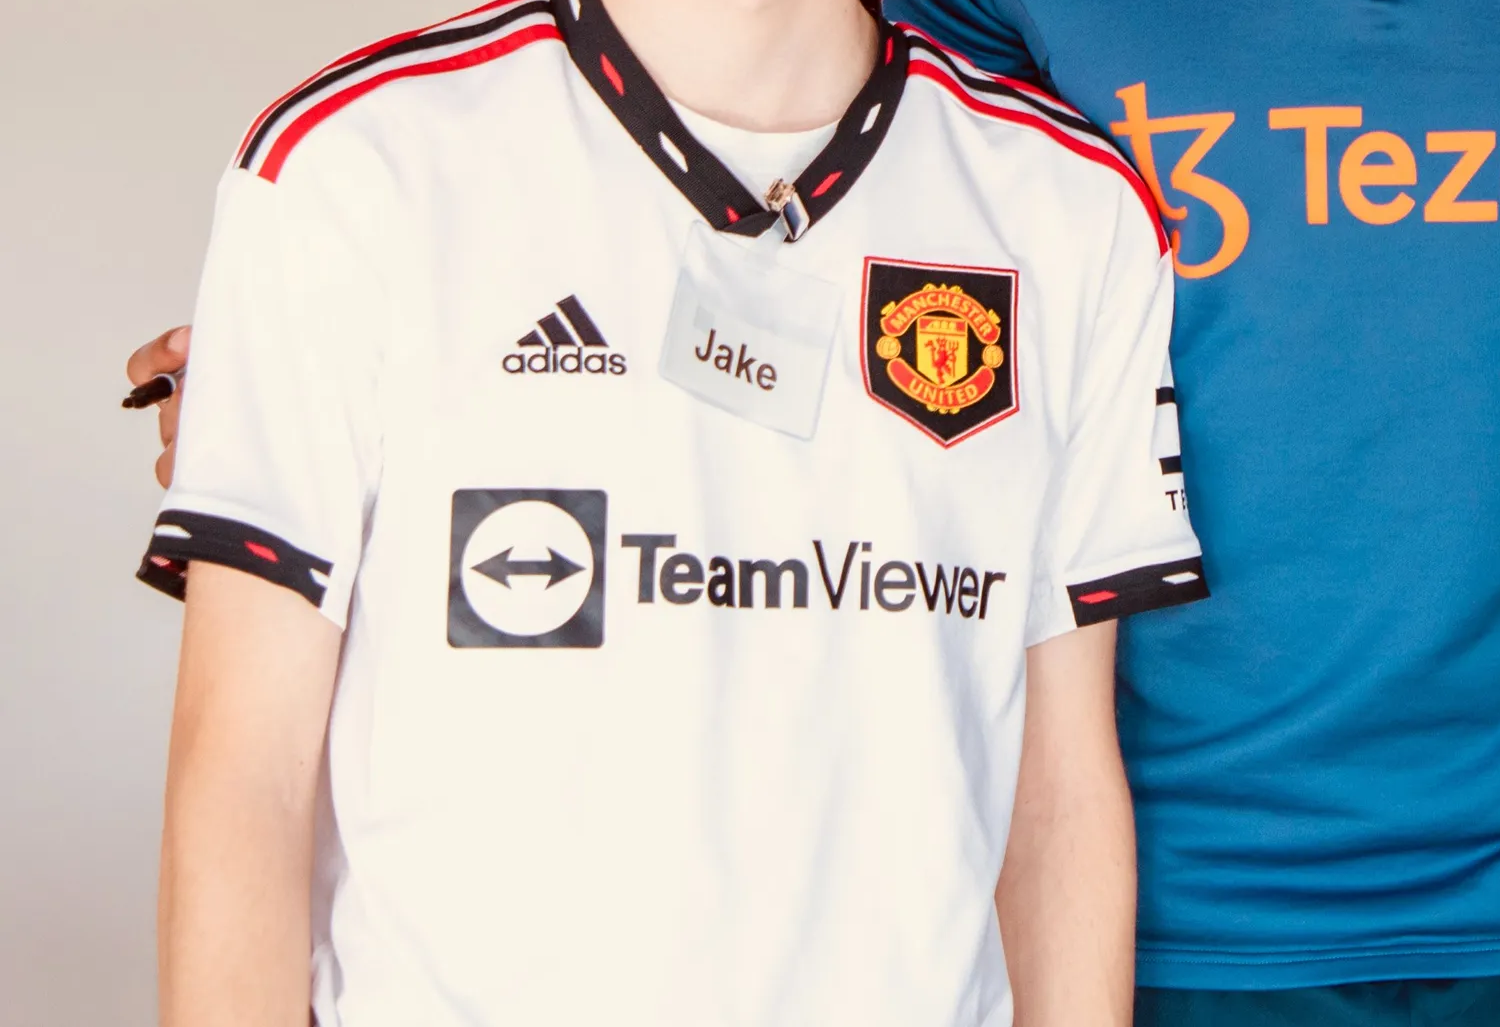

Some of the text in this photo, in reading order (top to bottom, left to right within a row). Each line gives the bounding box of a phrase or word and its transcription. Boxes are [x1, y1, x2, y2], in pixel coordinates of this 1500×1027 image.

[889, 292, 993, 337] MANCHESTER
[501, 345, 628, 376] adidas
[695, 329, 778, 391] Jake
[908, 377, 979, 405] UNITED
[620, 533, 1007, 620] TeamViewer
